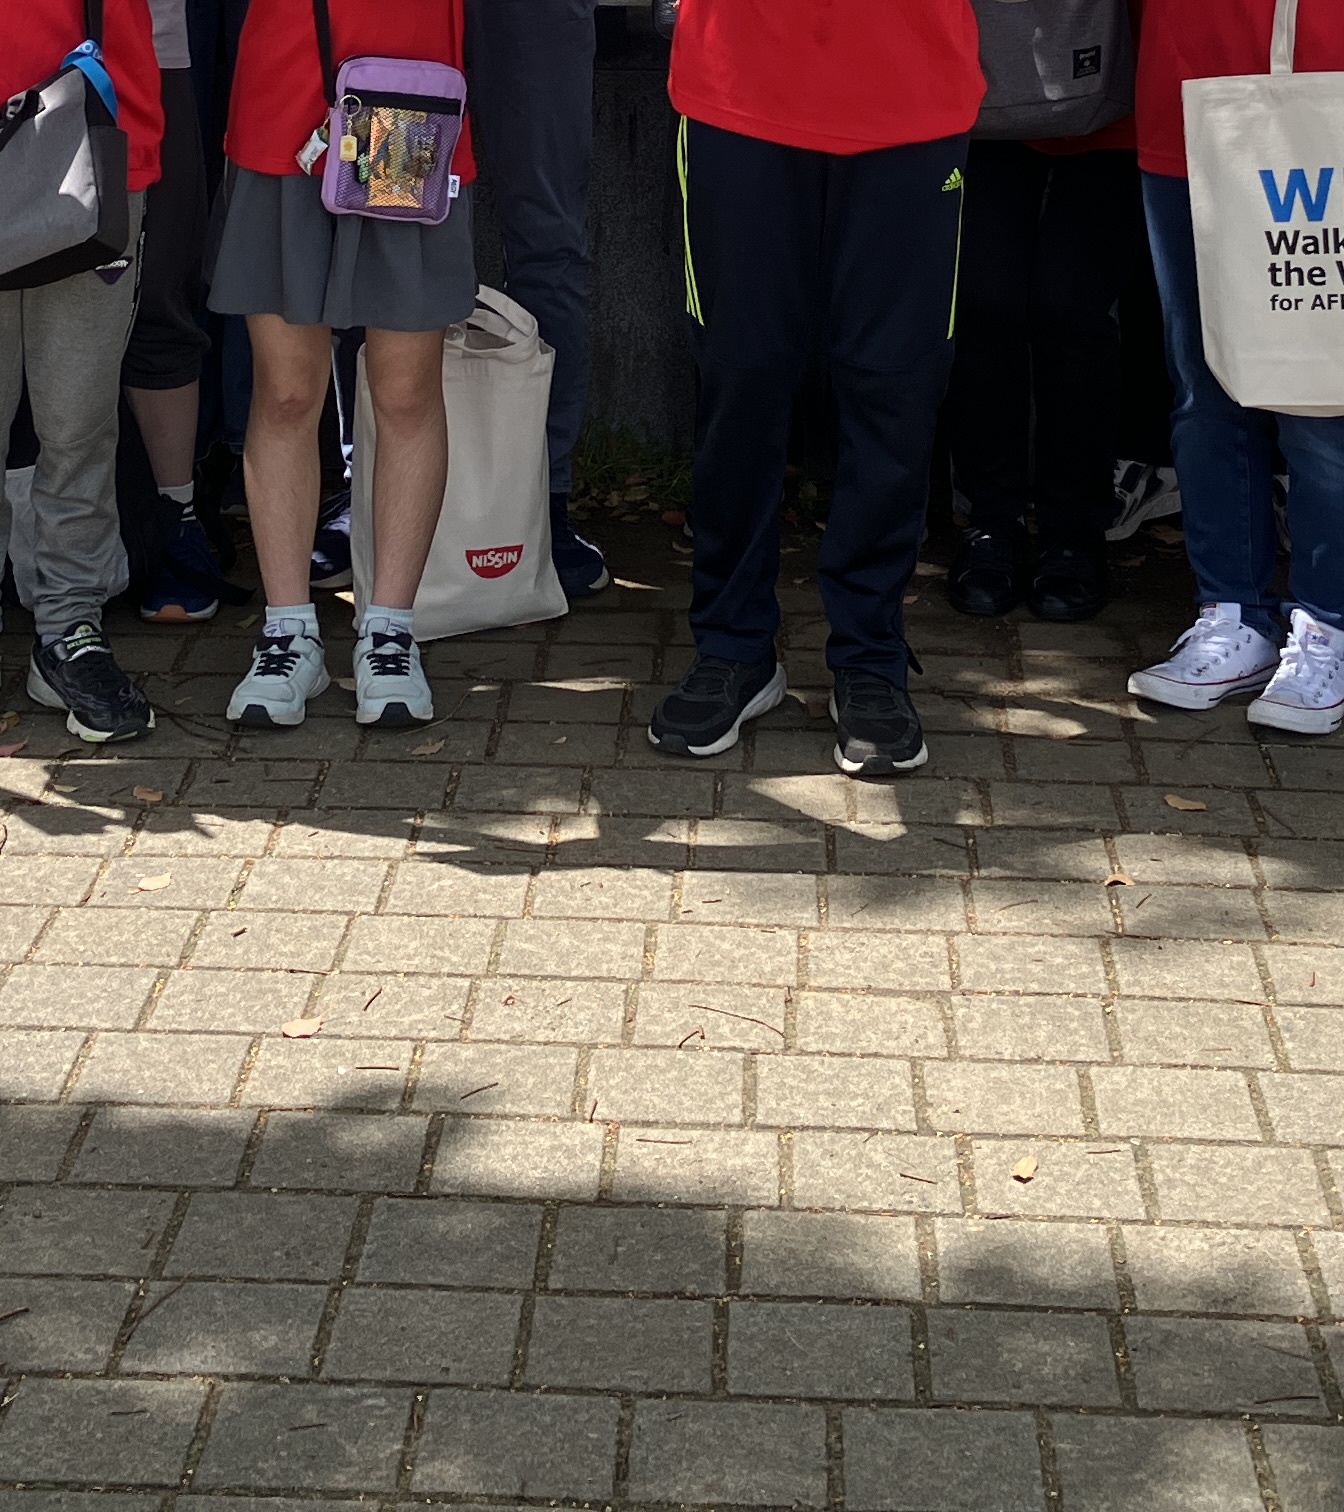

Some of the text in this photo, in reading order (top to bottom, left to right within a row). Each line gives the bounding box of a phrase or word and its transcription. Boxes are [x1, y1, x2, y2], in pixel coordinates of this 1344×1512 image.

[1267, 260, 1327, 287] the
[1269, 293, 1304, 311] for
[471, 550, 518, 569] NISSIN
